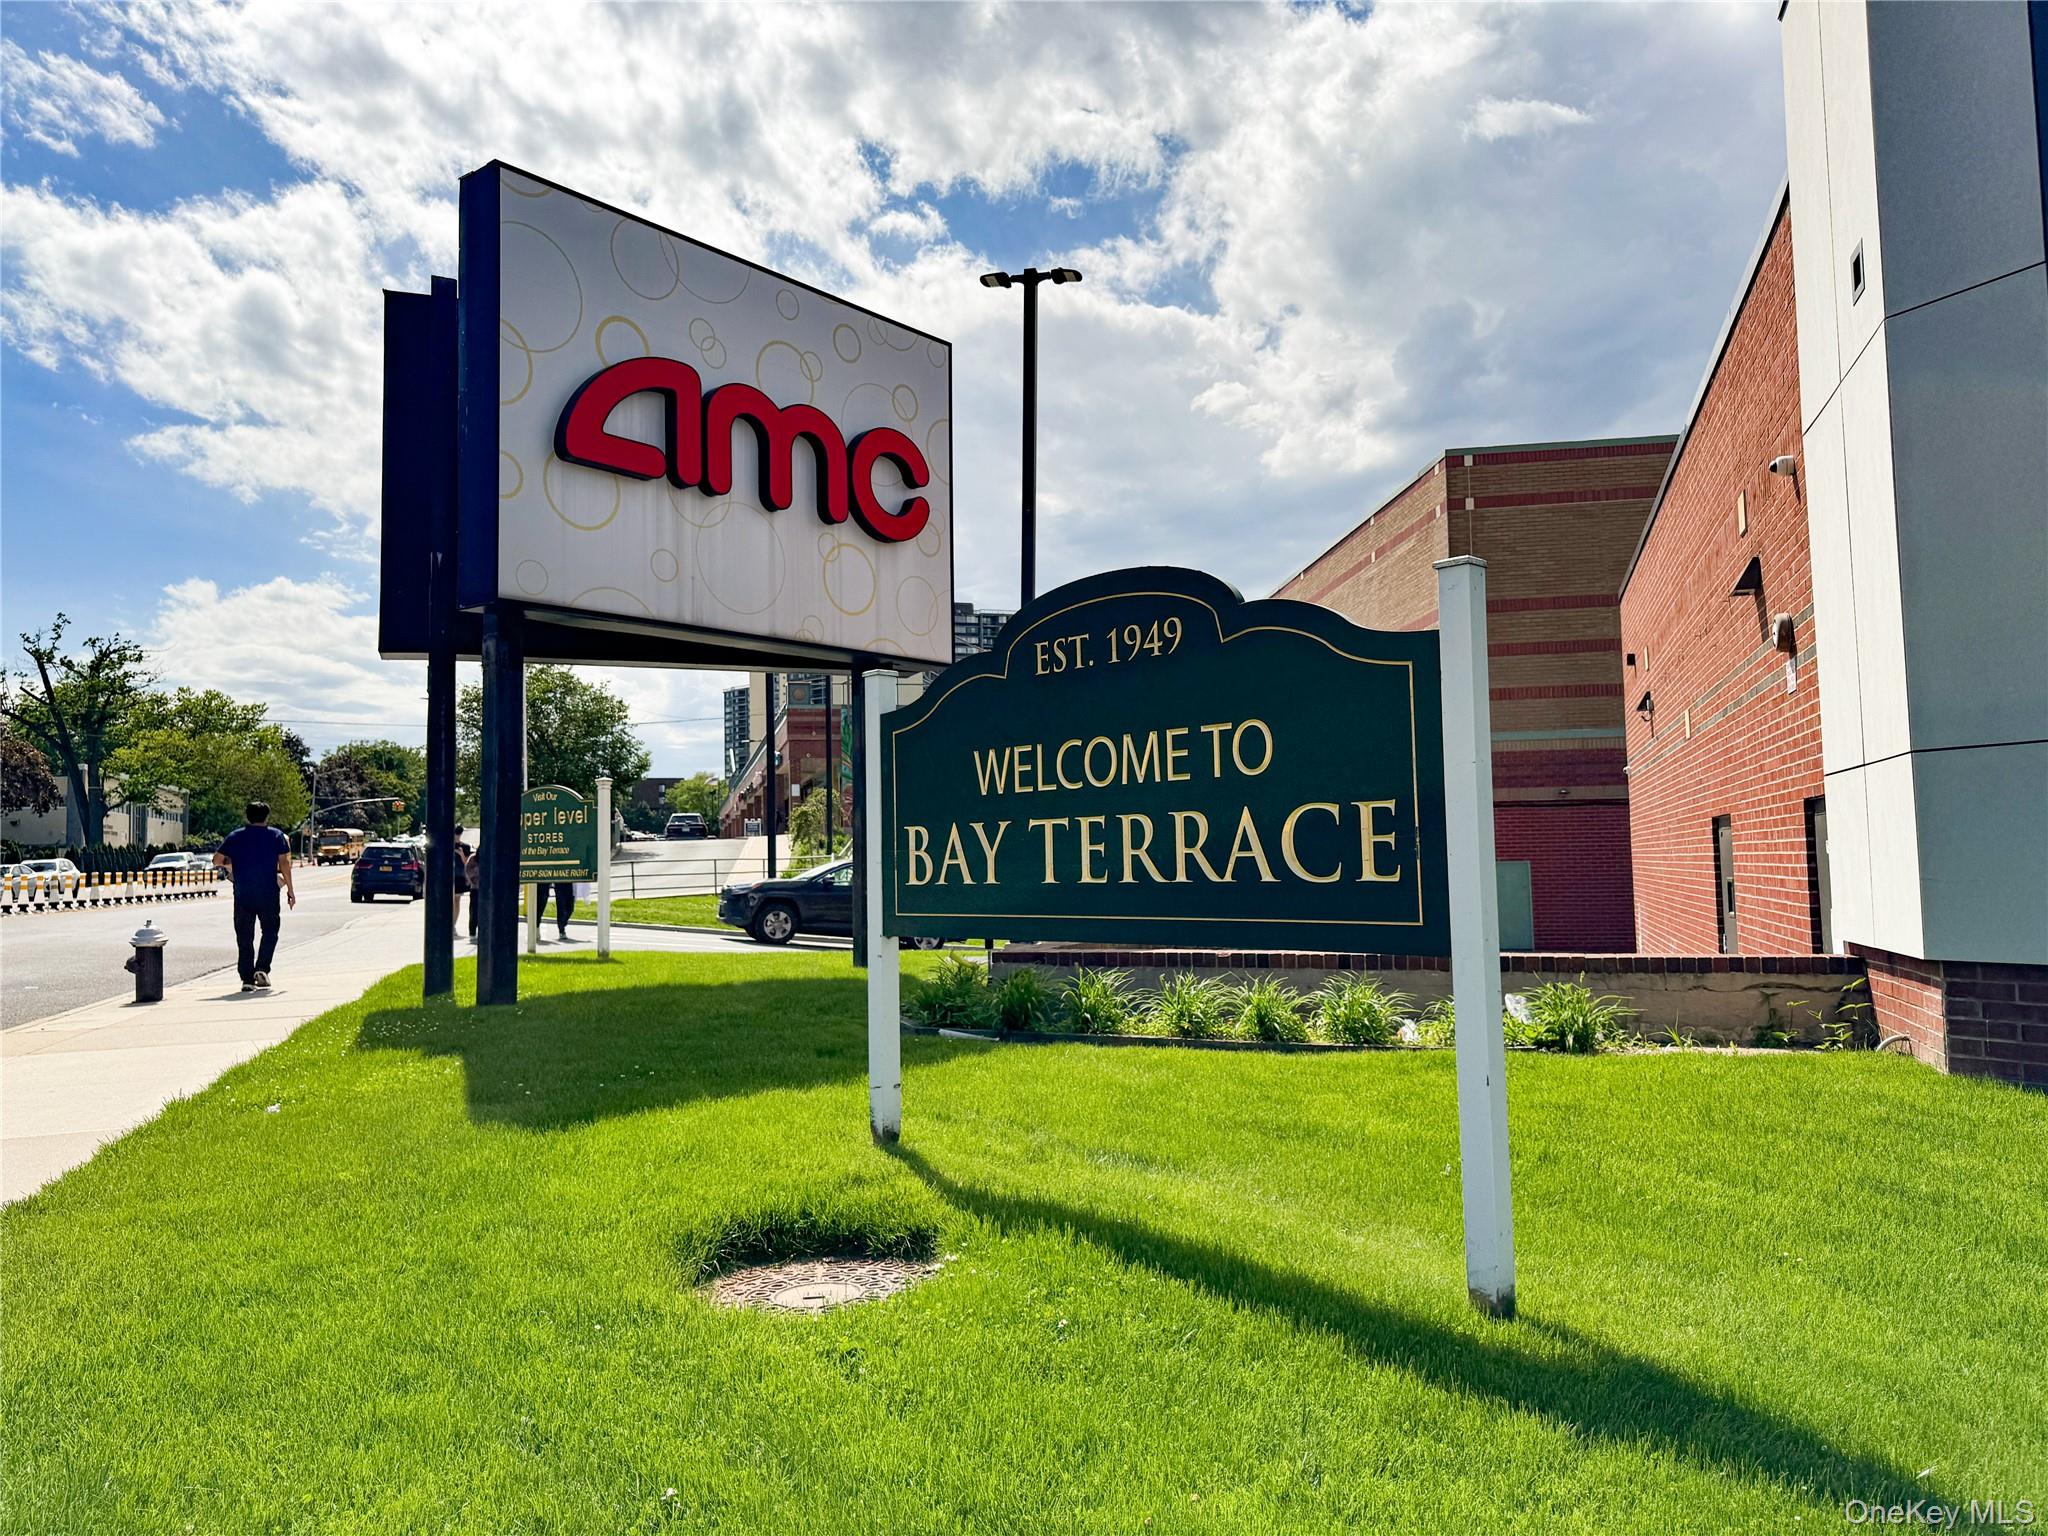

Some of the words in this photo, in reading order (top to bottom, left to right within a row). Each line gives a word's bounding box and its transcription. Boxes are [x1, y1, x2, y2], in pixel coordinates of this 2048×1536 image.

[554, 356, 930, 543] amc
[1034, 633, 1094, 676] EST.
[1107, 616, 1182, 664] 1949
[973, 727, 1191, 796] WELCOME
[1201, 718, 1273, 778] TO
[533, 792, 545, 802] Visit
[546, 791, 558, 801] Our
[554, 805, 588, 825] level
[527, 832, 564, 844] STORES
[903, 820, 1012, 886] BAY
[1028, 798, 1402, 884] TERRACE
[537, 846, 548, 856] Bay
[549, 846, 570, 854] Terrace
[522, 869, 538, 878] STOP
[538, 869, 553, 877] SIGN
[553, 869, 570, 877] MAKE
[570, 868, 589, 877] RIGHT
